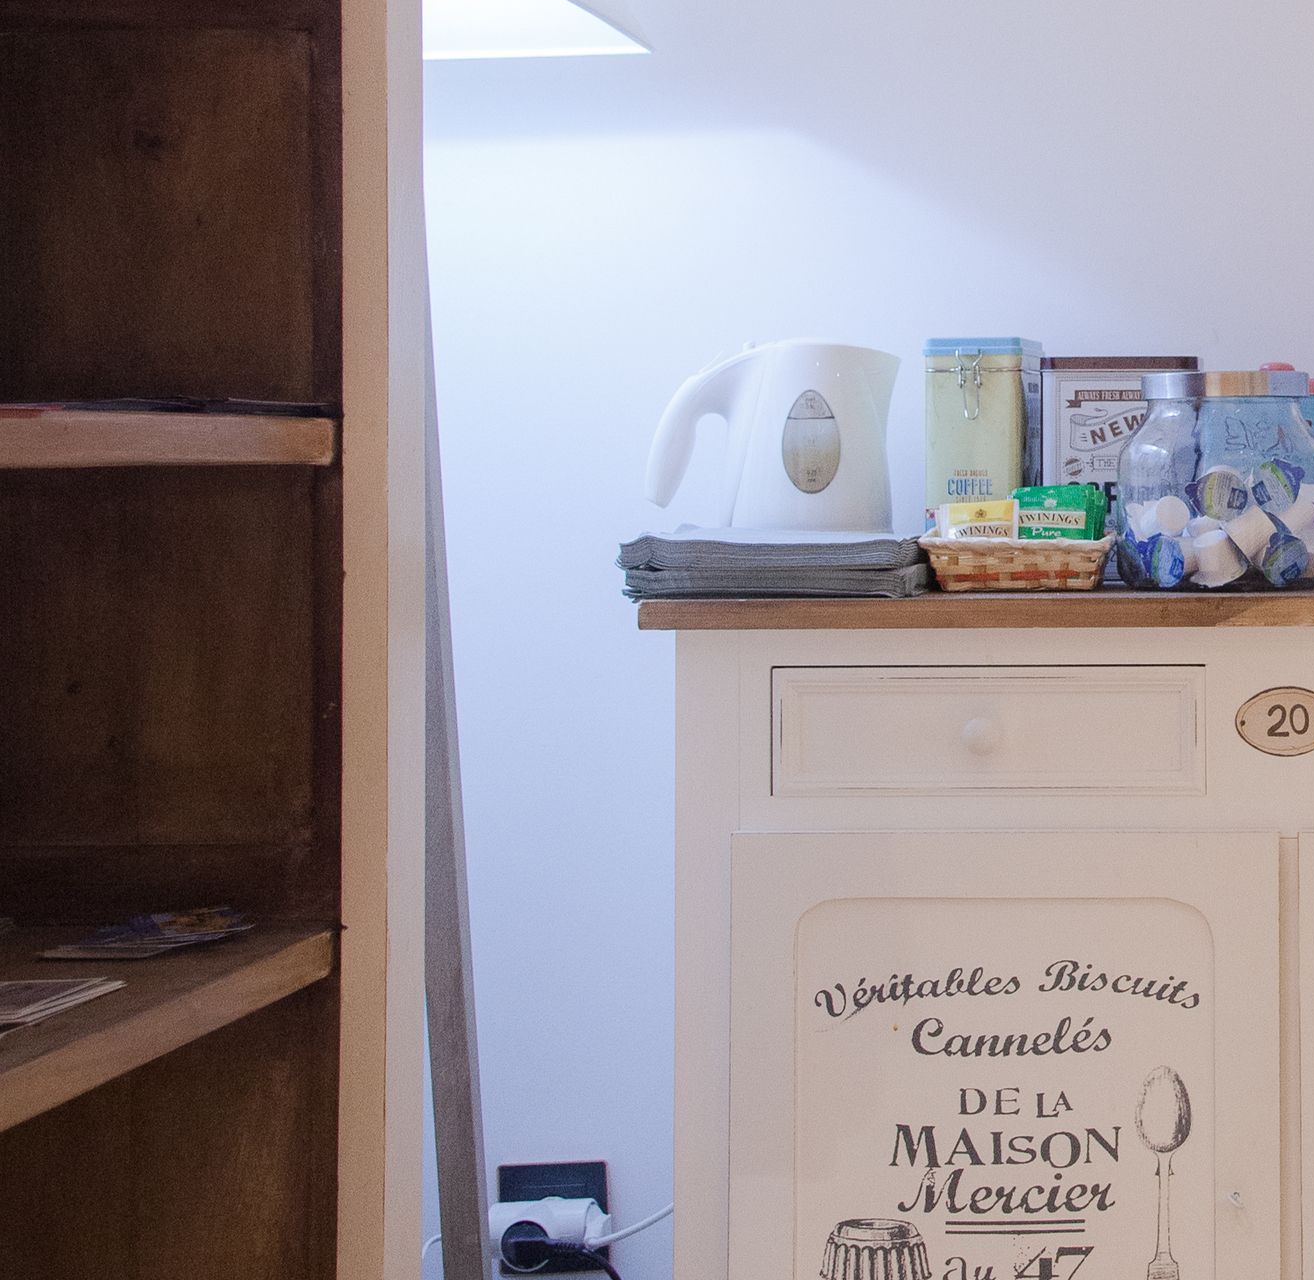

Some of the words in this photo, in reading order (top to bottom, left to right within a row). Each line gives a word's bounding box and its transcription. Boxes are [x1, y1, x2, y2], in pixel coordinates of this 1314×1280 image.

[1078, 391, 1100, 400] ALWAYS
[1101, 391, 1120, 400] FRESH
[1122, 391, 1141, 400] ALWAY
[947, 478, 993, 496] COFFEE
[1019, 513, 1081, 525] TWININGS
[1031, 527, 1062, 537] Pure
[1267, 704, 1310, 737] 20
[1039, 960, 1199, 1008] Biscuits
[912, 1017, 1111, 1057] Cannelés
[959, 1088, 1020, 1115] DE
[1036, 1091, 1073, 1118] LA
[889, 1124, 1121, 1169] MAISON
[898, 1167, 1115, 1214] Mercier
